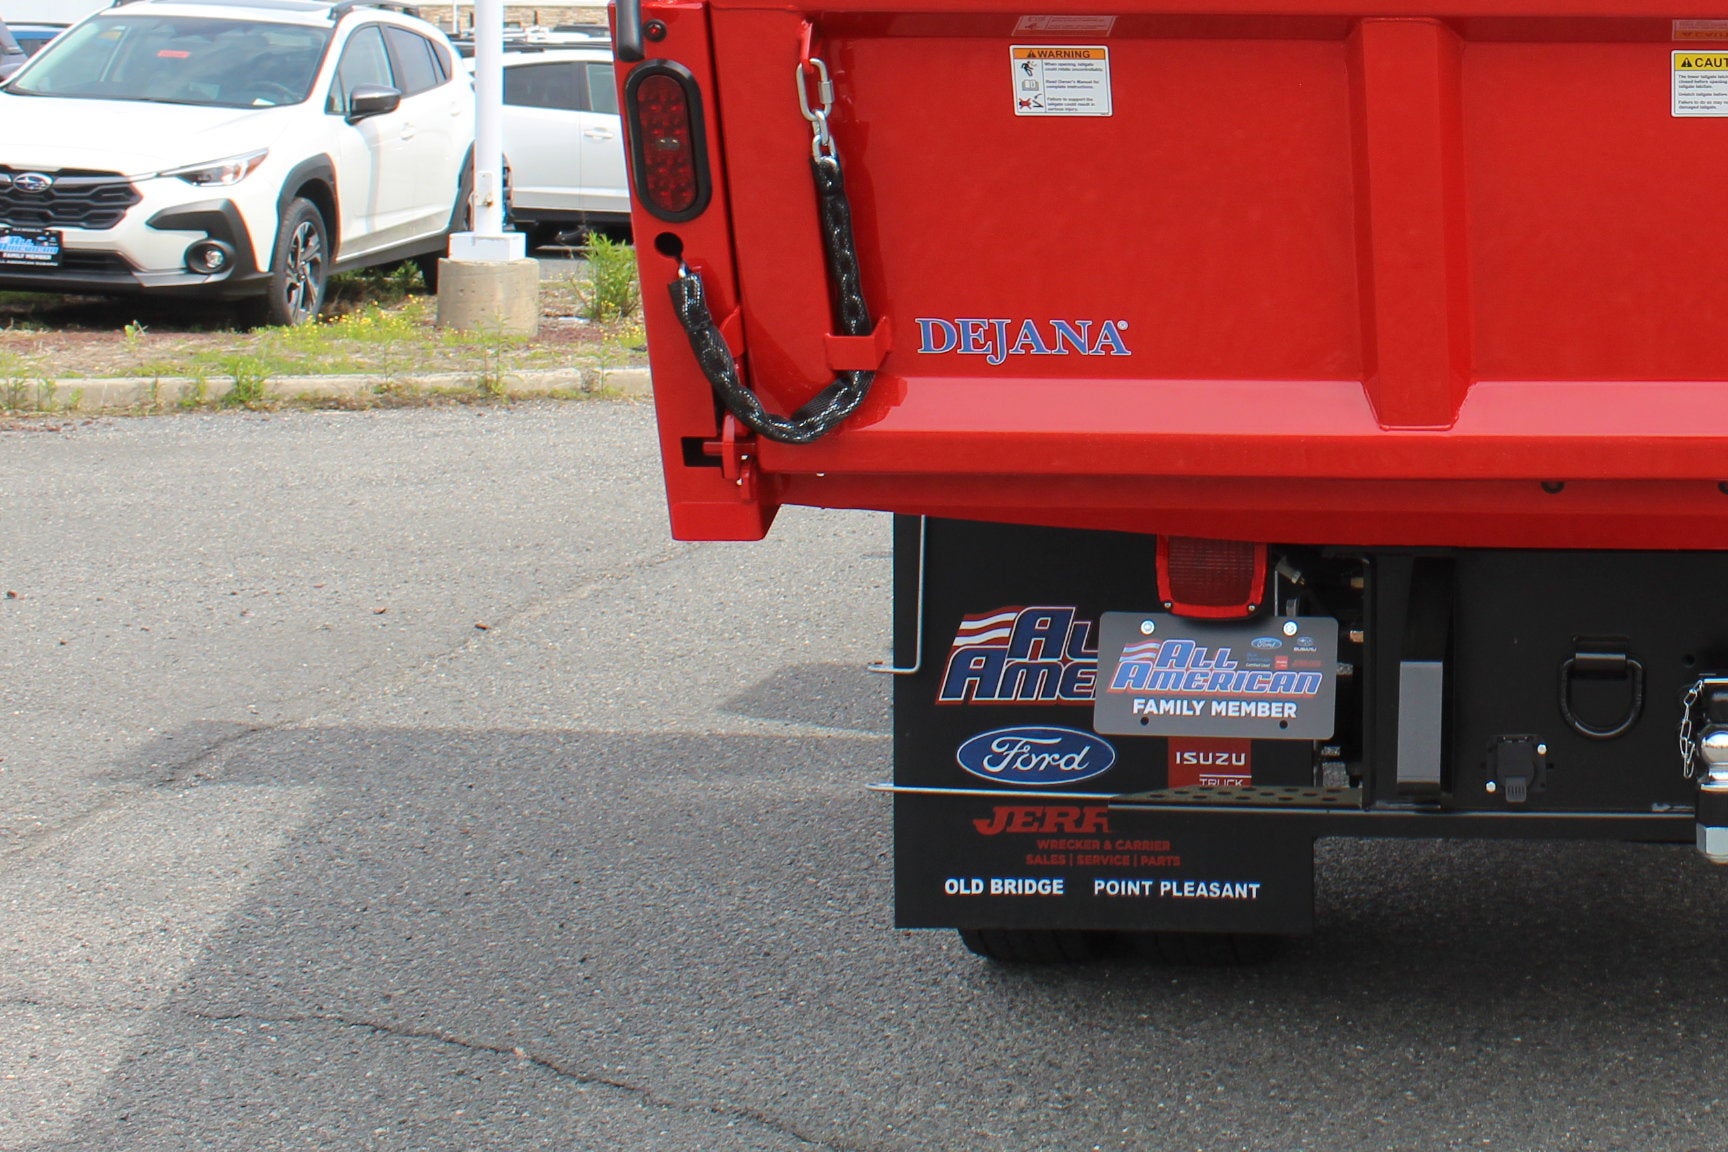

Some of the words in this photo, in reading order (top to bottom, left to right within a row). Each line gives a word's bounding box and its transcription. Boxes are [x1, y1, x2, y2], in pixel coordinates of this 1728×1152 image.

[1038, 50, 1090, 58] WARNING
[1006, 607, 1098, 661] AL
[1153, 639, 1239, 669] ALL
[936, 645, 1098, 705] AME
[1108, 661, 1323, 697] AMERICAN
[1133, 698, 1205, 716] FAMILY
[1211, 700, 1297, 718] MEMBER
[983, 736, 1091, 773] Ford
[1176, 752, 1246, 765] ISUZU
[1036, 839, 1100, 851] WRECKER
[1103, 840, 1112, 851] &
[1115, 840, 1171, 851] CARRIER
[1026, 854, 1066, 865] SALES
[1077, 854, 1131, 866] SERVICE
[1141, 856, 1181, 867] PARTS
[945, 878, 984, 895] OLD
[990, 879, 1064, 895] BRIDGE
[1094, 880, 1152, 896] POINT
[1160, 881, 1260, 898] PLEASANT
